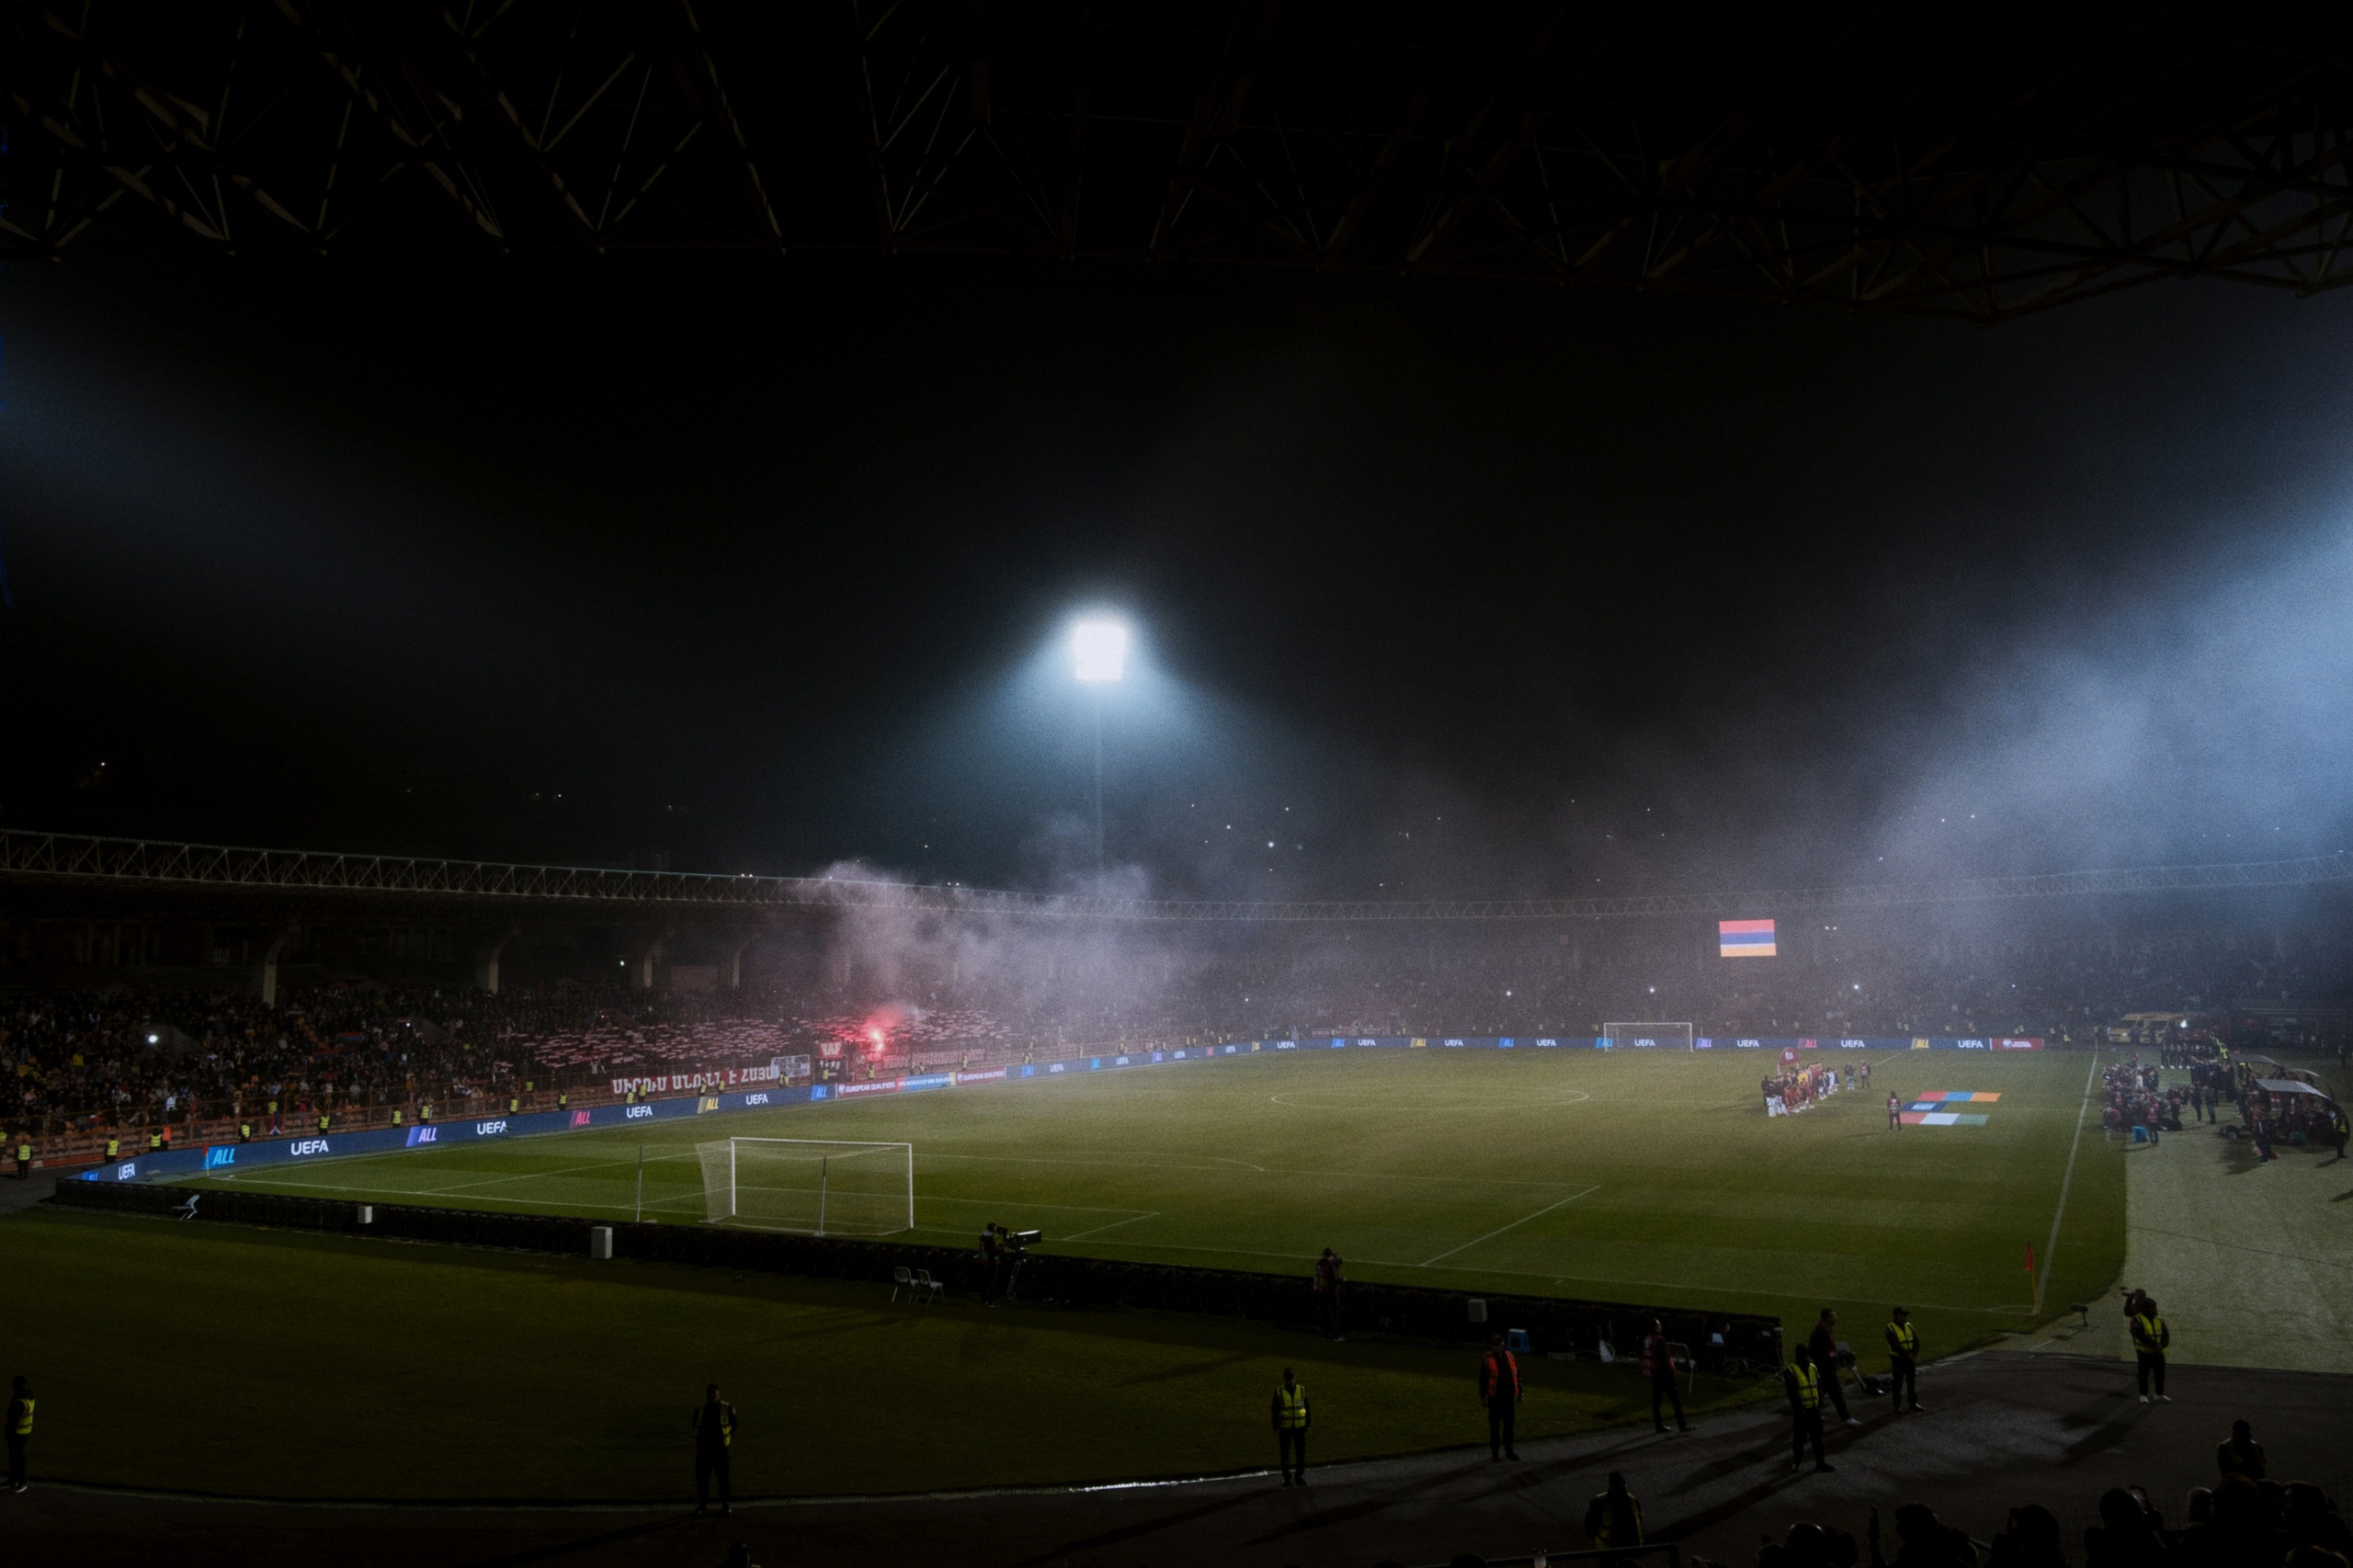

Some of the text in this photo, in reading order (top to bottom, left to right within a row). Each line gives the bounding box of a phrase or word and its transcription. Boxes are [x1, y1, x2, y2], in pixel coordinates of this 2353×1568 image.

[1634, 1039, 1655, 1047] UEFA
[1736, 1040, 1759, 1048] UEFA
[1804, 1040, 1817, 1048] ALL
[1840, 1040, 1865, 1048] UEFA
[1916, 1040, 1929, 1048] ALL
[1958, 1040, 1984, 1048] UEFA
[1050, 1063, 1064, 1073] UEFA
[705, 1097, 719, 1110] ALL
[745, 1093, 768, 1105] UEFA
[576, 1111, 591, 1125] ALL
[627, 1106, 653, 1119] UEFA
[477, 1121, 507, 1135] UEFA
[418, 1127, 437, 1142] ALL
[290, 1140, 329, 1156] UEFA
[213, 1148, 235, 1165] ALL
[118, 1163, 135, 1180] UEFA
